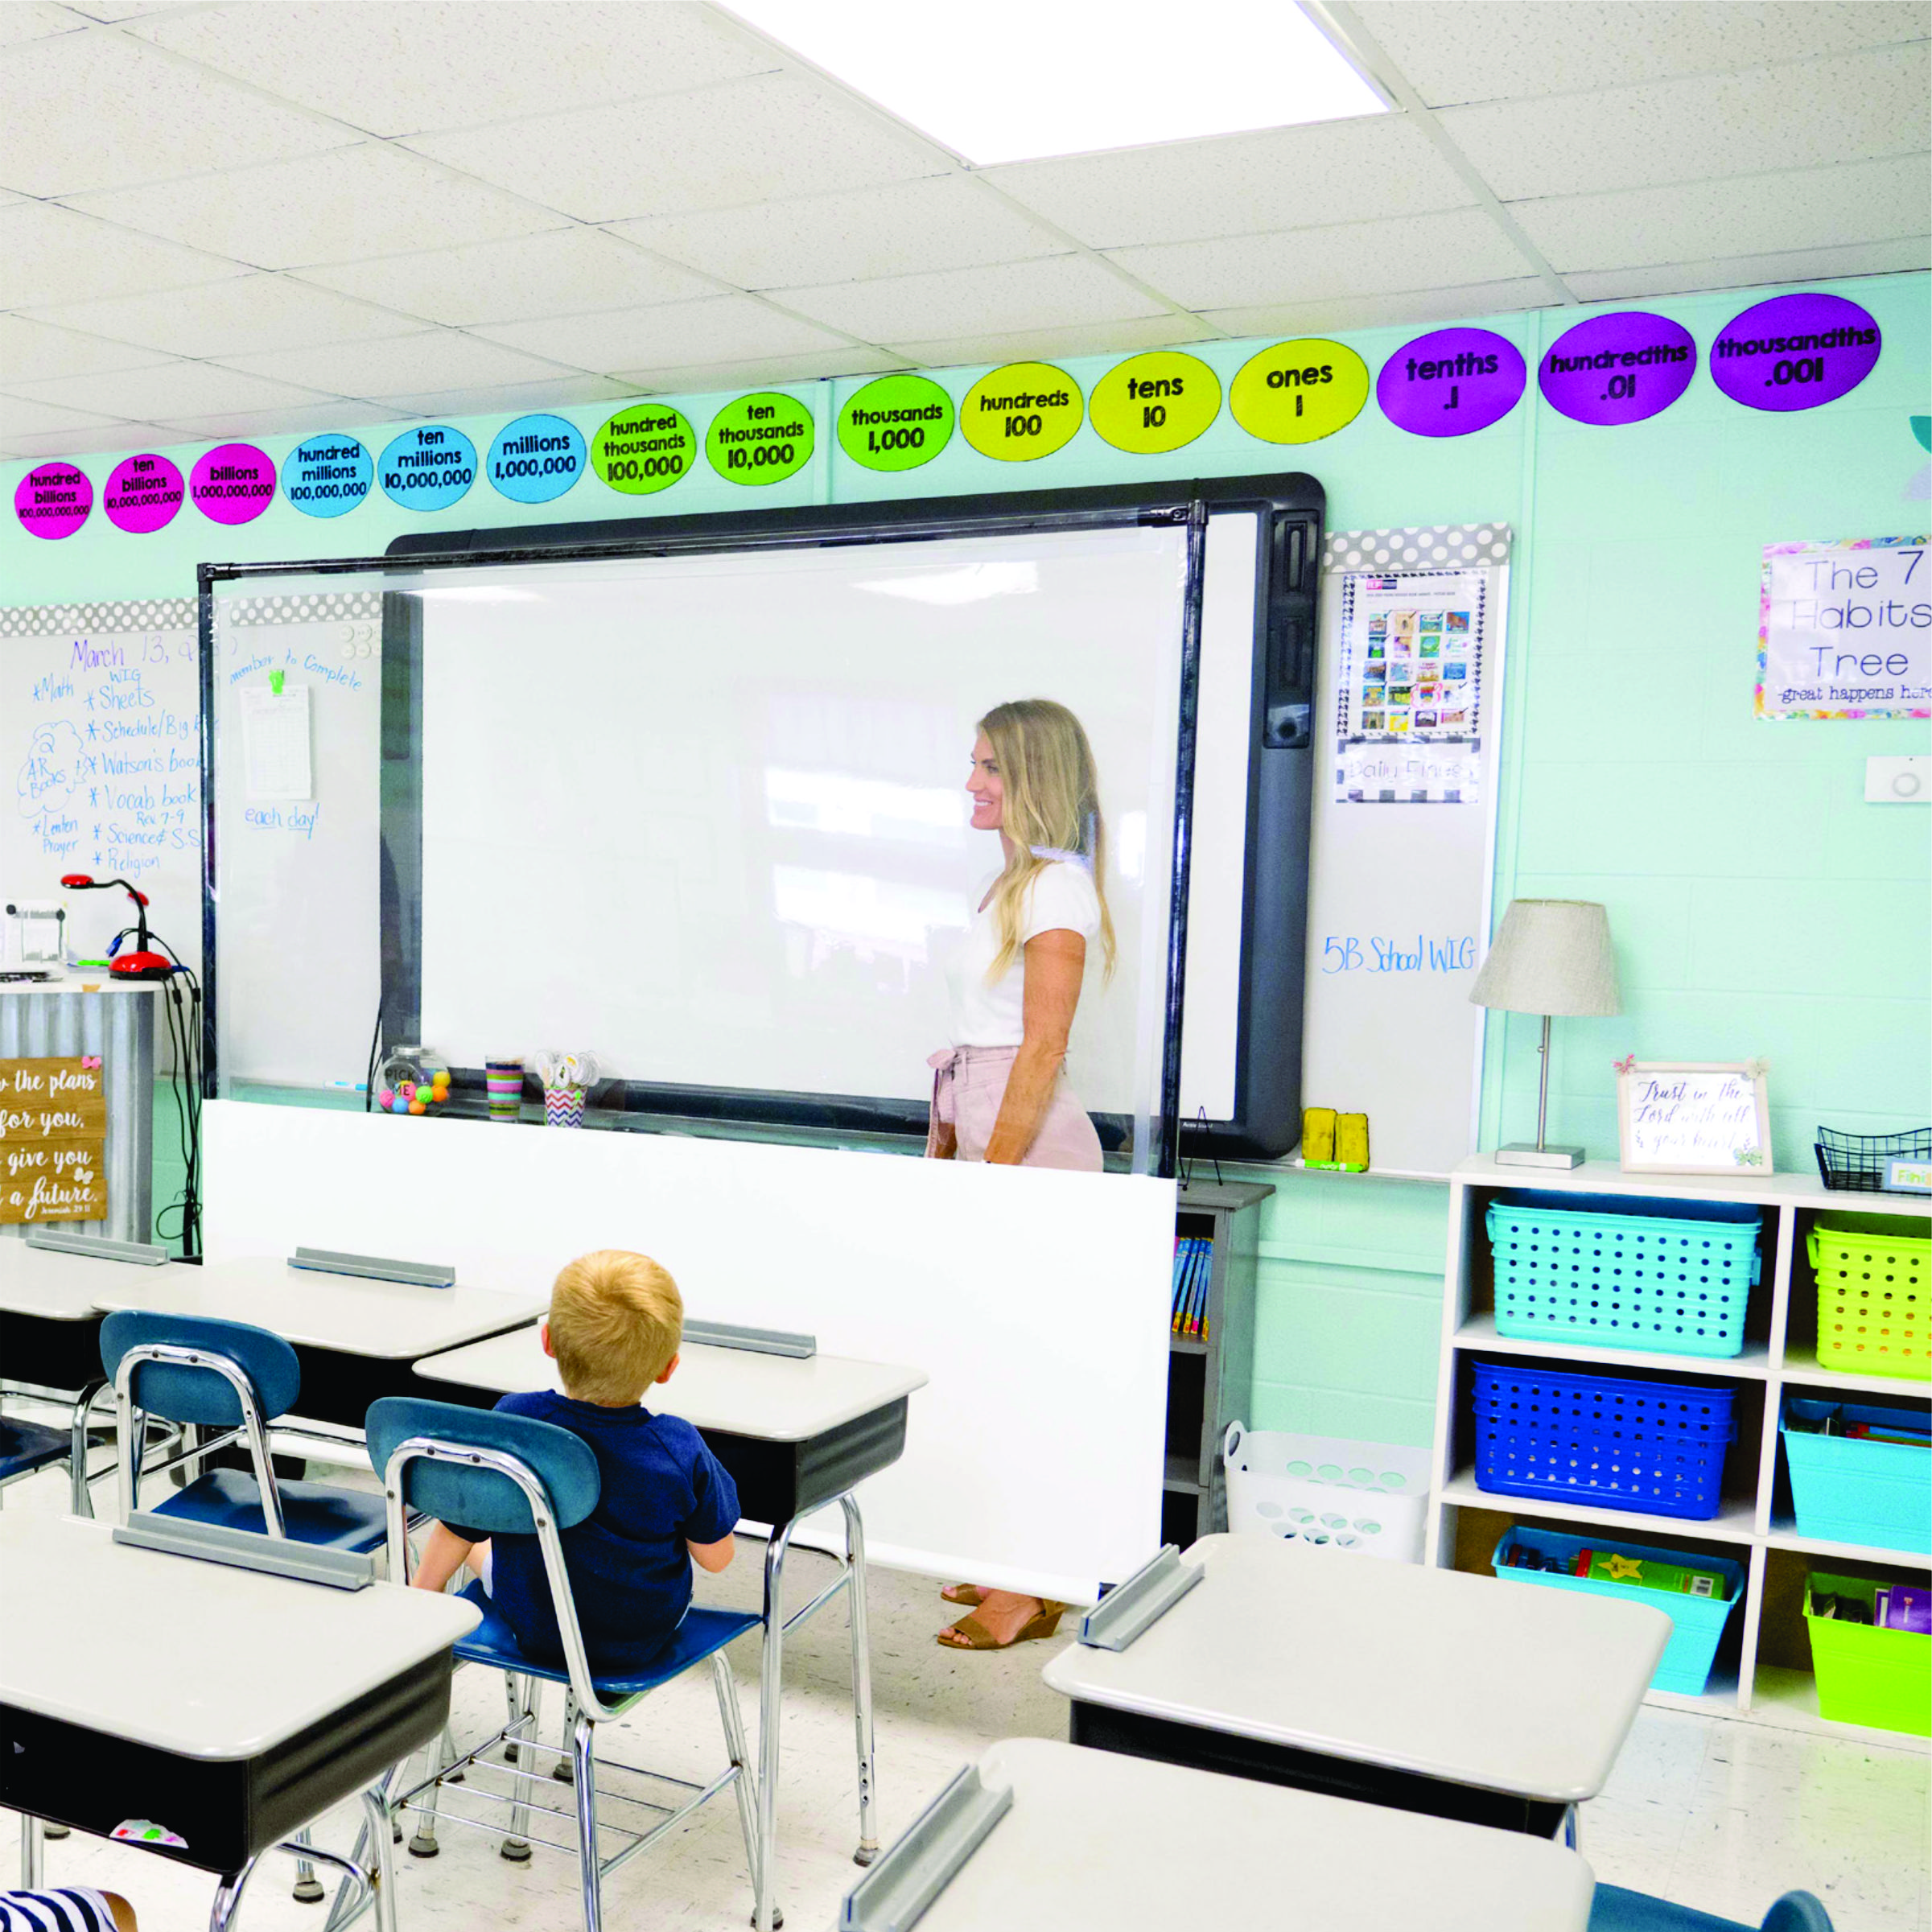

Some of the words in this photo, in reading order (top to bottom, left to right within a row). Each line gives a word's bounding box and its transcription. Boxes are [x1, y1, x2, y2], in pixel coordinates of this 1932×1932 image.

[1718, 327, 1876, 357] thousandths
[1406, 351, 1499, 382] tenths
[1551, 344, 1688, 374] hundredths
[1267, 365, 1333, 388] ones
[1765, 357, 1823, 388] .001
[1128, 376, 1184, 400] tens
[1444, 386, 1458, 410] .1
[1600, 374, 1636, 401] .01
[980, 389, 1069, 411] hundreds
[1296, 395, 1303, 417] 1
[748, 406, 775, 421] ten
[851, 404, 943, 426] thousands
[1143, 406, 1166, 428] 10
[610, 414, 677, 437] hundred
[719, 422, 804, 444] thousands
[1005, 414, 1042, 437] 100
[418, 430, 444, 447] ten
[503, 435, 570, 455] millions
[603, 434, 686, 457] thousands
[868, 426, 925, 453] 1,000
[298, 443, 360, 463] hundred
[398, 451, 462, 468] millions
[728, 443, 794, 471] 10,000
[134, 459, 154, 472] ten
[209, 466, 258, 481] billions
[302, 465, 356, 482] millions
[496, 455, 576, 481] 1,000,000
[608, 455, 682, 482] 100,000
[30, 472, 80, 488] hundred
[122, 477, 167, 493] billions
[290, 481, 367, 501] 100,000,000
[385, 468, 472, 492] 10,000,000
[35, 491, 76, 505] billions
[107, 491, 181, 510] 10,000,000,000
[193, 484, 272, 500] 1,000,000,000
[1805, 561, 1878, 591] The
[1897, 550, 1924, 585] 7
[1792, 599, 1932, 629] Habits
[70, 639, 124, 672] March
[142, 634, 169, 663] 13,
[1809, 646, 1909, 677] Tree
[109, 669, 141, 682] WIG
[286, 648, 297, 664] to
[304, 653, 362, 691] Complete
[100, 681, 154, 710] Sheets
[1829, 686, 1893, 702] happens
[102, 751, 164, 776] Watson's
[105, 785, 154, 810] Vocab
[163, 782, 197, 807] book
[245, 808, 282, 827] each
[288, 802, 320, 840] day!
[43, 838, 78, 860] Prayer
[108, 847, 159, 879] Religion
[1322, 937, 1364, 974] 5B
[1366, 934, 1423, 973] School
[1429, 936, 1476, 974] WIG
[15, 1069, 44, 1092] the
[49, 1069, 97, 1098] plans
[385, 1069, 418, 1081] PICK
[393, 1083, 410, 1096] ME
[1638, 1081, 1690, 1102] Trust
[1694, 1090, 1707, 1100] in
[1719, 1079, 1742, 1101] the
[0, 1109, 34, 1138] for
[1634, 1105, 1679, 1123] Lord
[8, 1148, 48, 1176] give
[54, 1151, 93, 1174] you
[10, 1191, 24, 1205] a
[25, 1176, 97, 1220] future.
